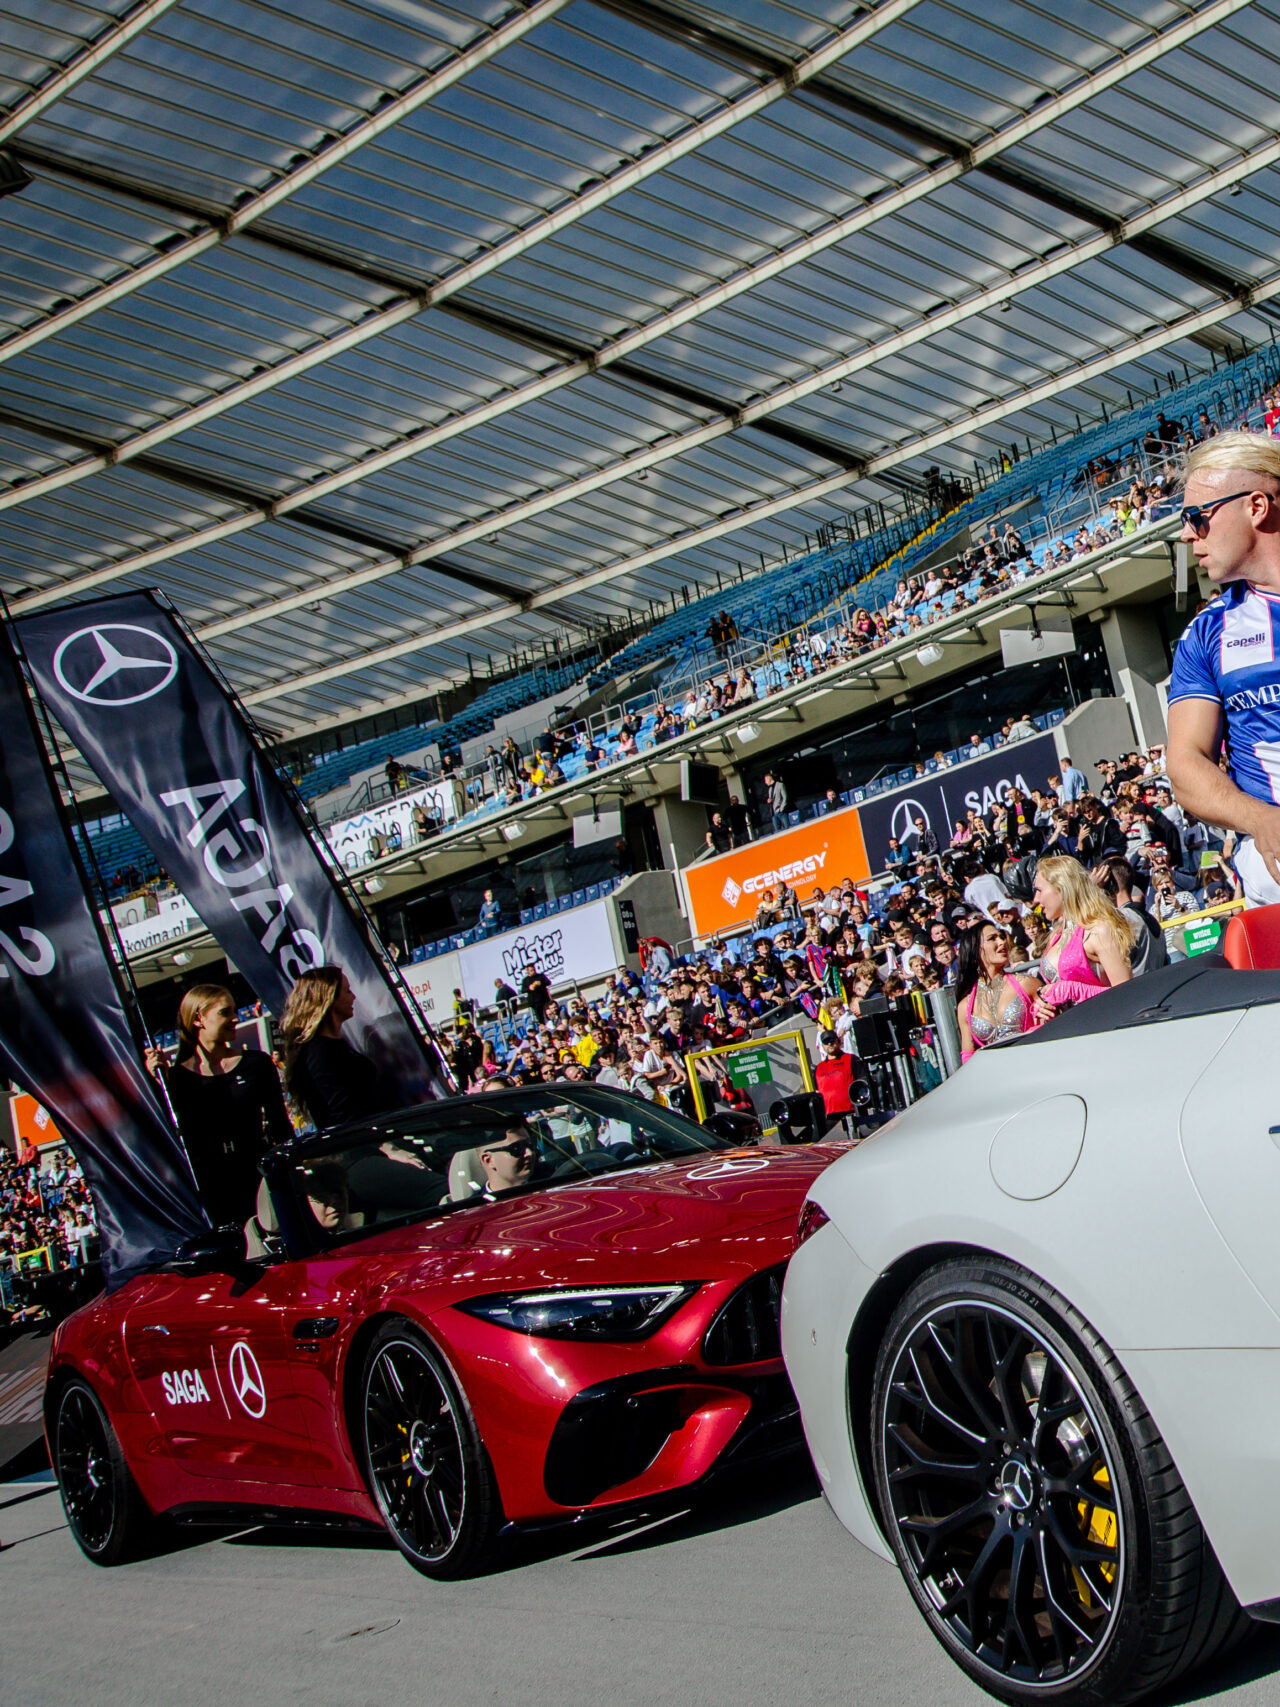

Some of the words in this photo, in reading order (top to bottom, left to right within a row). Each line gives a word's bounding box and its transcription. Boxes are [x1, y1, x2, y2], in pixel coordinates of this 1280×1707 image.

[1226, 632, 1265, 648] capelli
[964, 773, 1032, 817] SAGA
[742, 851, 827, 894] GCENERGY
[502, 928, 562, 977] Mister
[746, 1071, 760, 1084] 15
[161, 1368, 211, 1405] SAGA
